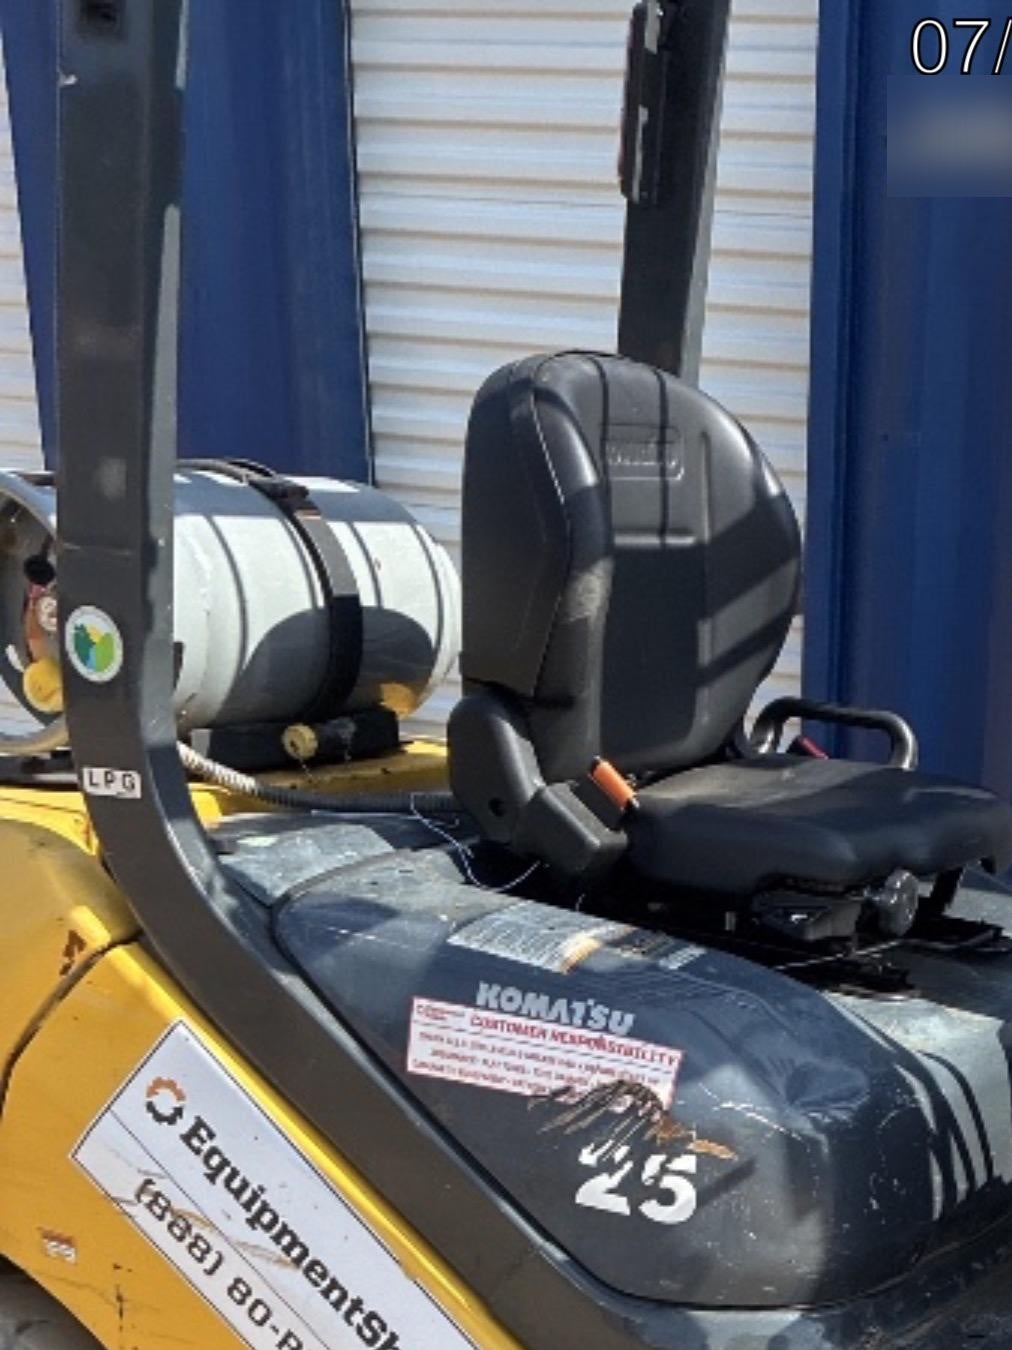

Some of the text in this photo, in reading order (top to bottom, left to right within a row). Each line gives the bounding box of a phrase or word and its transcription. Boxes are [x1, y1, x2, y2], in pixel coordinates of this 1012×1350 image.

[475, 980, 636, 1037] KOMATSU
[575, 1140, 698, 1225] 25
[134, 1178, 225, 1277] (888)
